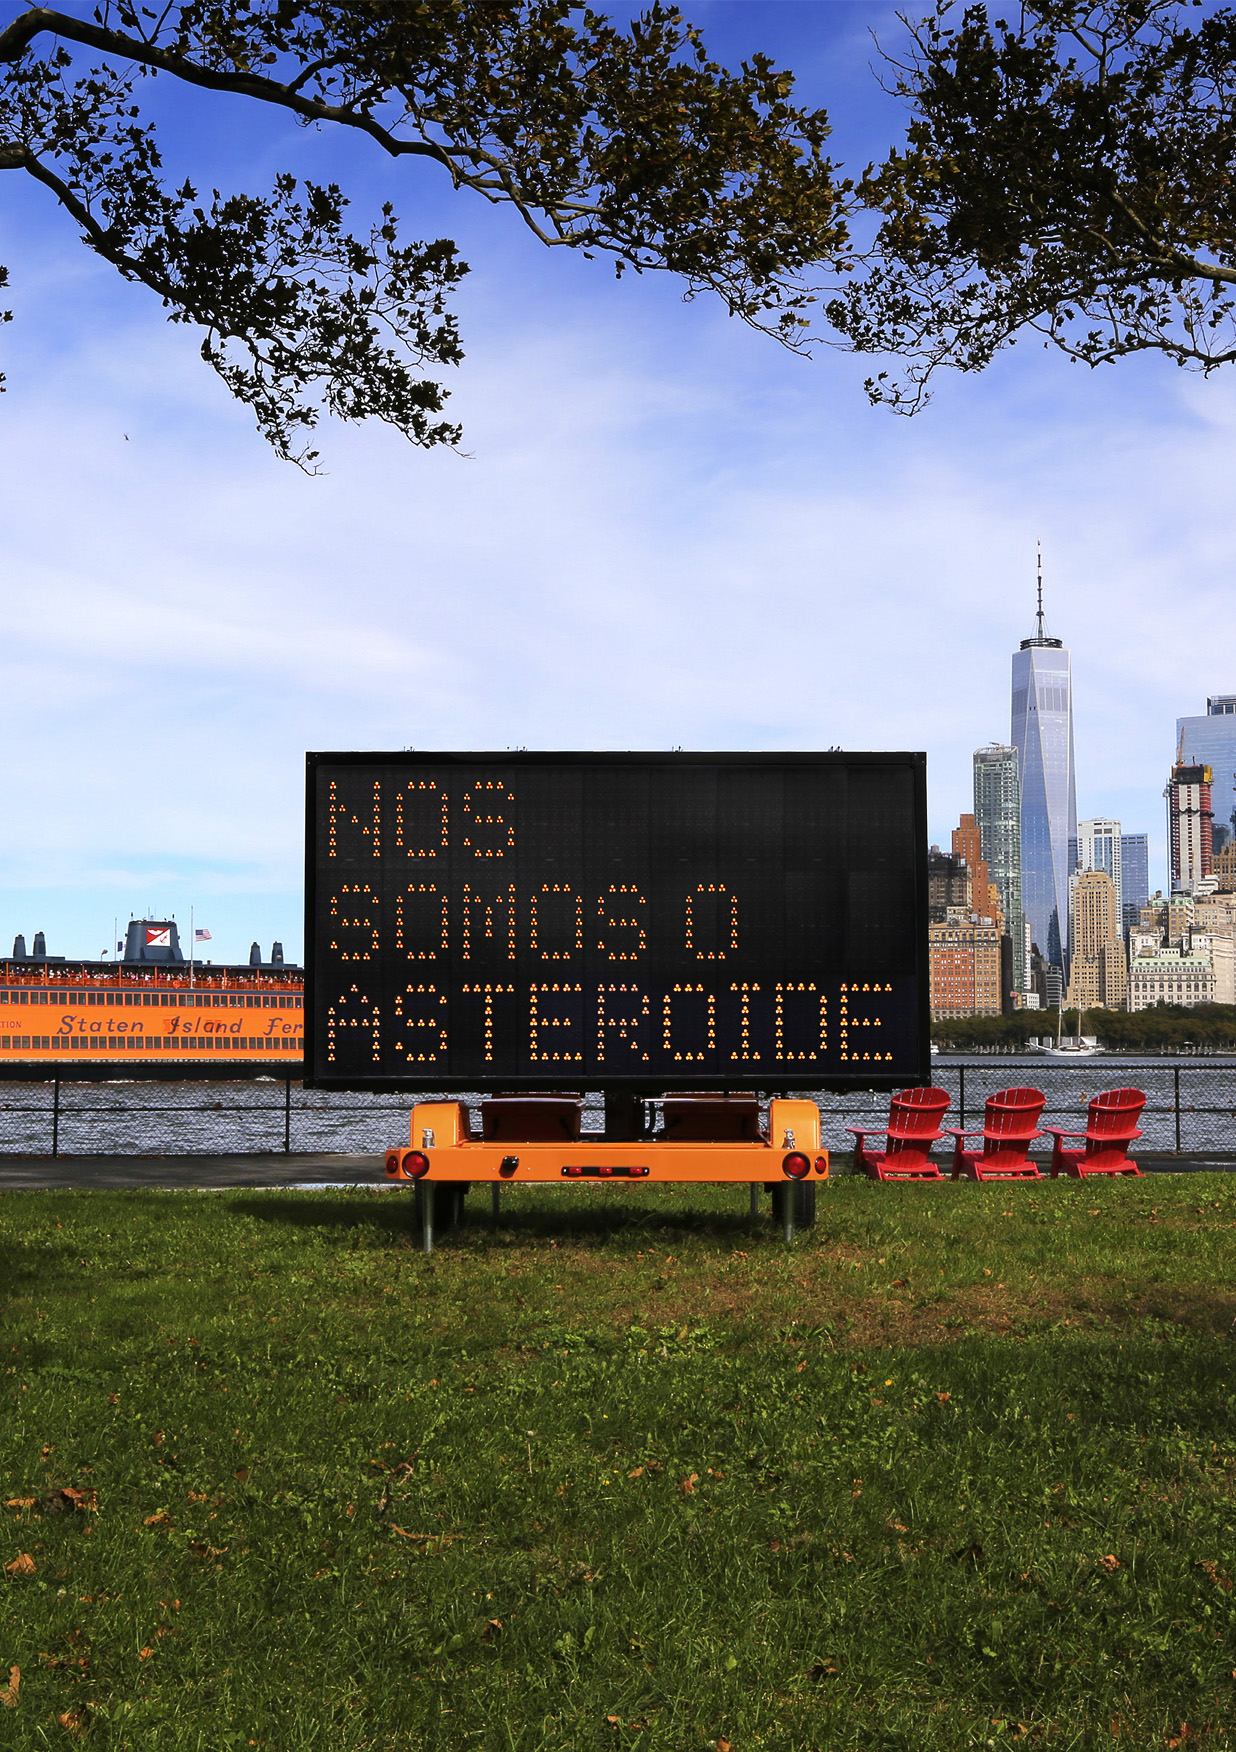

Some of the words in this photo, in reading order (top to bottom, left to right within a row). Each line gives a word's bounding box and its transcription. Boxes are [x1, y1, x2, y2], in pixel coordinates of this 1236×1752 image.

[329, 781, 515, 857] NOS
[330, 883, 647, 961] SOMOS
[685, 883, 739, 960] O
[0, 1020, 22, 1029] TION
[56, 1015, 144, 1035] Staten
[167, 1016, 243, 1035] Island
[263, 1017, 303, 1036] Fer
[327, 983, 893, 1062] ASTEROIDE
